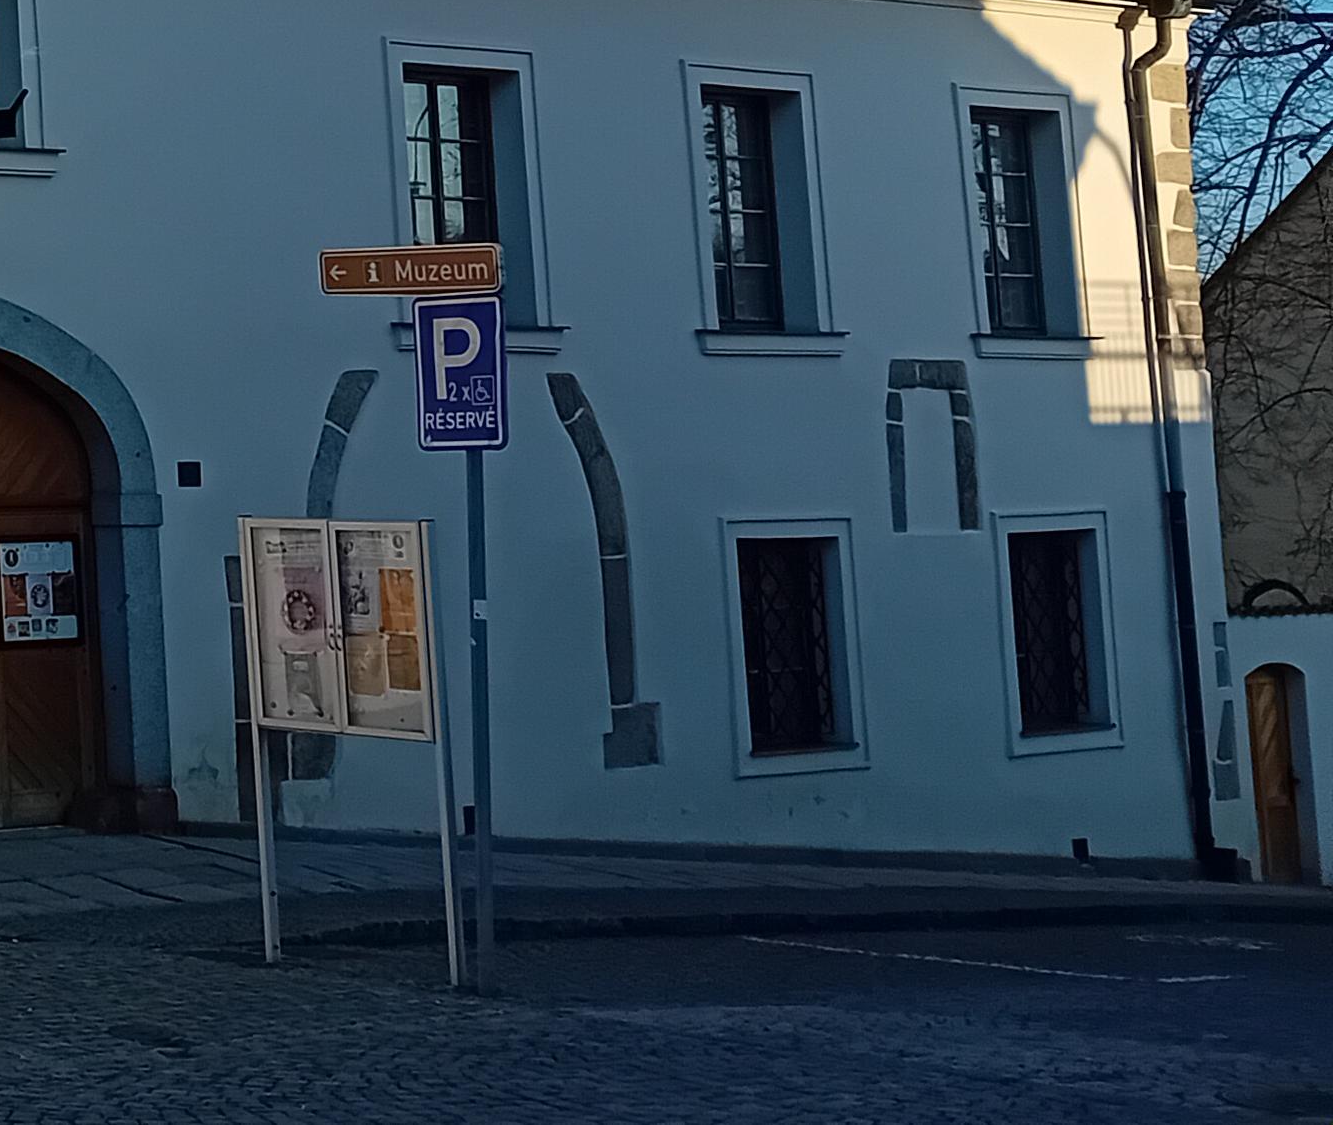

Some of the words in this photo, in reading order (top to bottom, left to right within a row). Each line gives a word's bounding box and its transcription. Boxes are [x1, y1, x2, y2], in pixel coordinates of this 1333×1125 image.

[394, 259, 488, 282] Muzeum
[433, 317, 481, 400] P
[448, 382, 458, 402] 2
[461, 386, 471, 401] x
